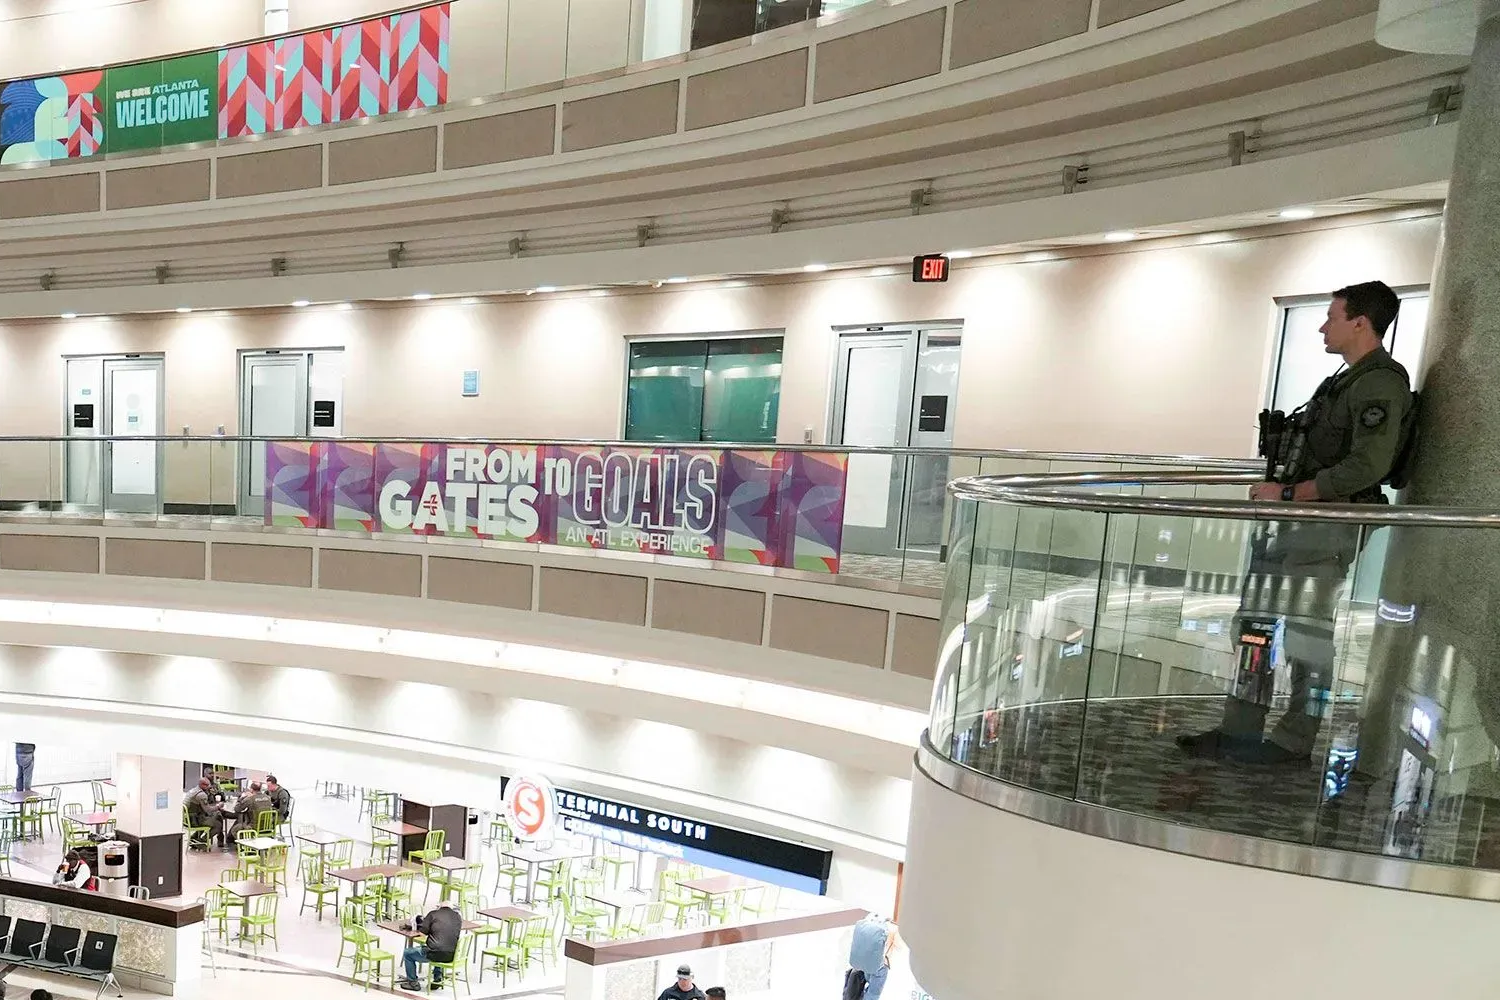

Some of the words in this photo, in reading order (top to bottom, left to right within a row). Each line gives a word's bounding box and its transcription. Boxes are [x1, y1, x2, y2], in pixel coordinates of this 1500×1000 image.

[152, 79, 199, 94] ATLANTA
[116, 89, 209, 128] WELCOME
[922, 259, 945, 279] EXIT
[446, 448, 537, 484] FROM
[379, 479, 540, 539] GATES
[544, 457, 572, 497] TO
[573, 451, 718, 534] GOALS
[565, 526, 587, 544] AN
[591, 528, 617, 546] ATL
[621, 533, 709, 555] EXPERIENCE
[556, 792, 640, 824] TERMINAL
[646, 813, 707, 840] SOUTH
